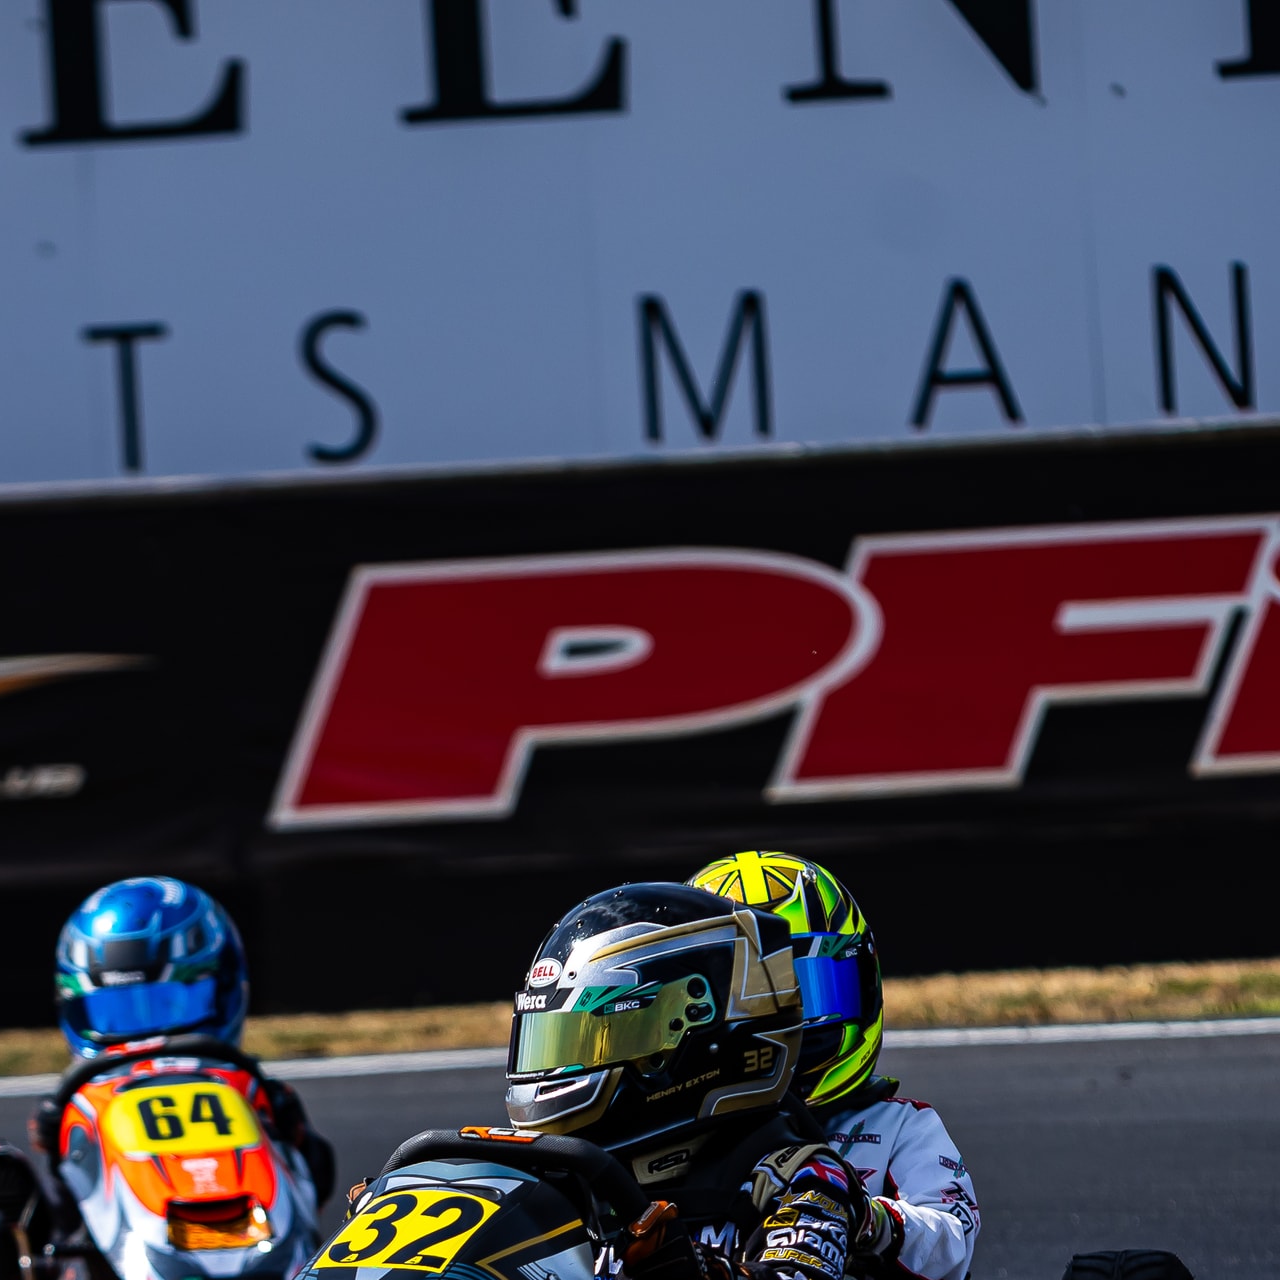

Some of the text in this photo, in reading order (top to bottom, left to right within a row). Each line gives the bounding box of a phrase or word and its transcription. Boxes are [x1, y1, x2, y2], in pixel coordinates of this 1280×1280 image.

[532, 965, 555, 979] BELL
[517, 992, 547, 1011] Wera
[615, 1001, 640, 1012] BKC
[744, 1046, 773, 1073] 32
[646, 1067, 720, 1103] HENRY EXTON
[137, 1093, 233, 1140] 64
[328, 1194, 484, 1269] 32
